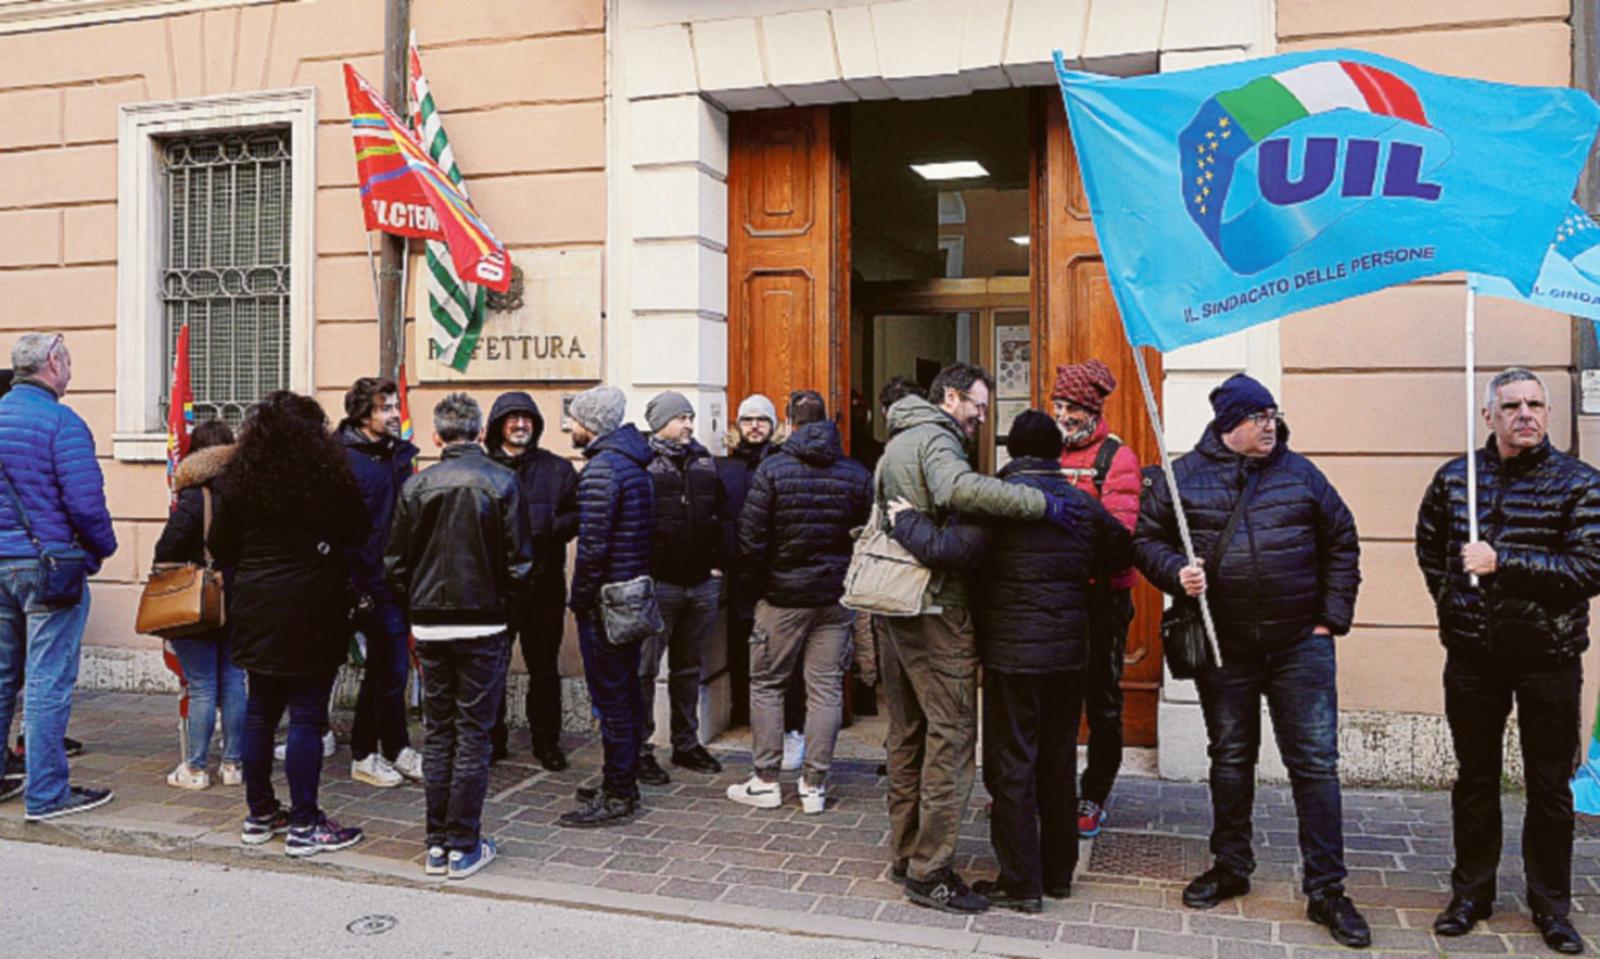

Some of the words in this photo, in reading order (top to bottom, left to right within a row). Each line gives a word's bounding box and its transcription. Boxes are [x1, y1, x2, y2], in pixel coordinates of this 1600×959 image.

[1258, 137, 1442, 206] UIL
[1184, 308, 1199, 323] IL
[1202, 279, 1290, 318] SINDACATO
[1295, 263, 1347, 289] DELLE
[1352, 247, 1436, 273] PERSONE
[428, 335, 586, 361] PFETTURA
